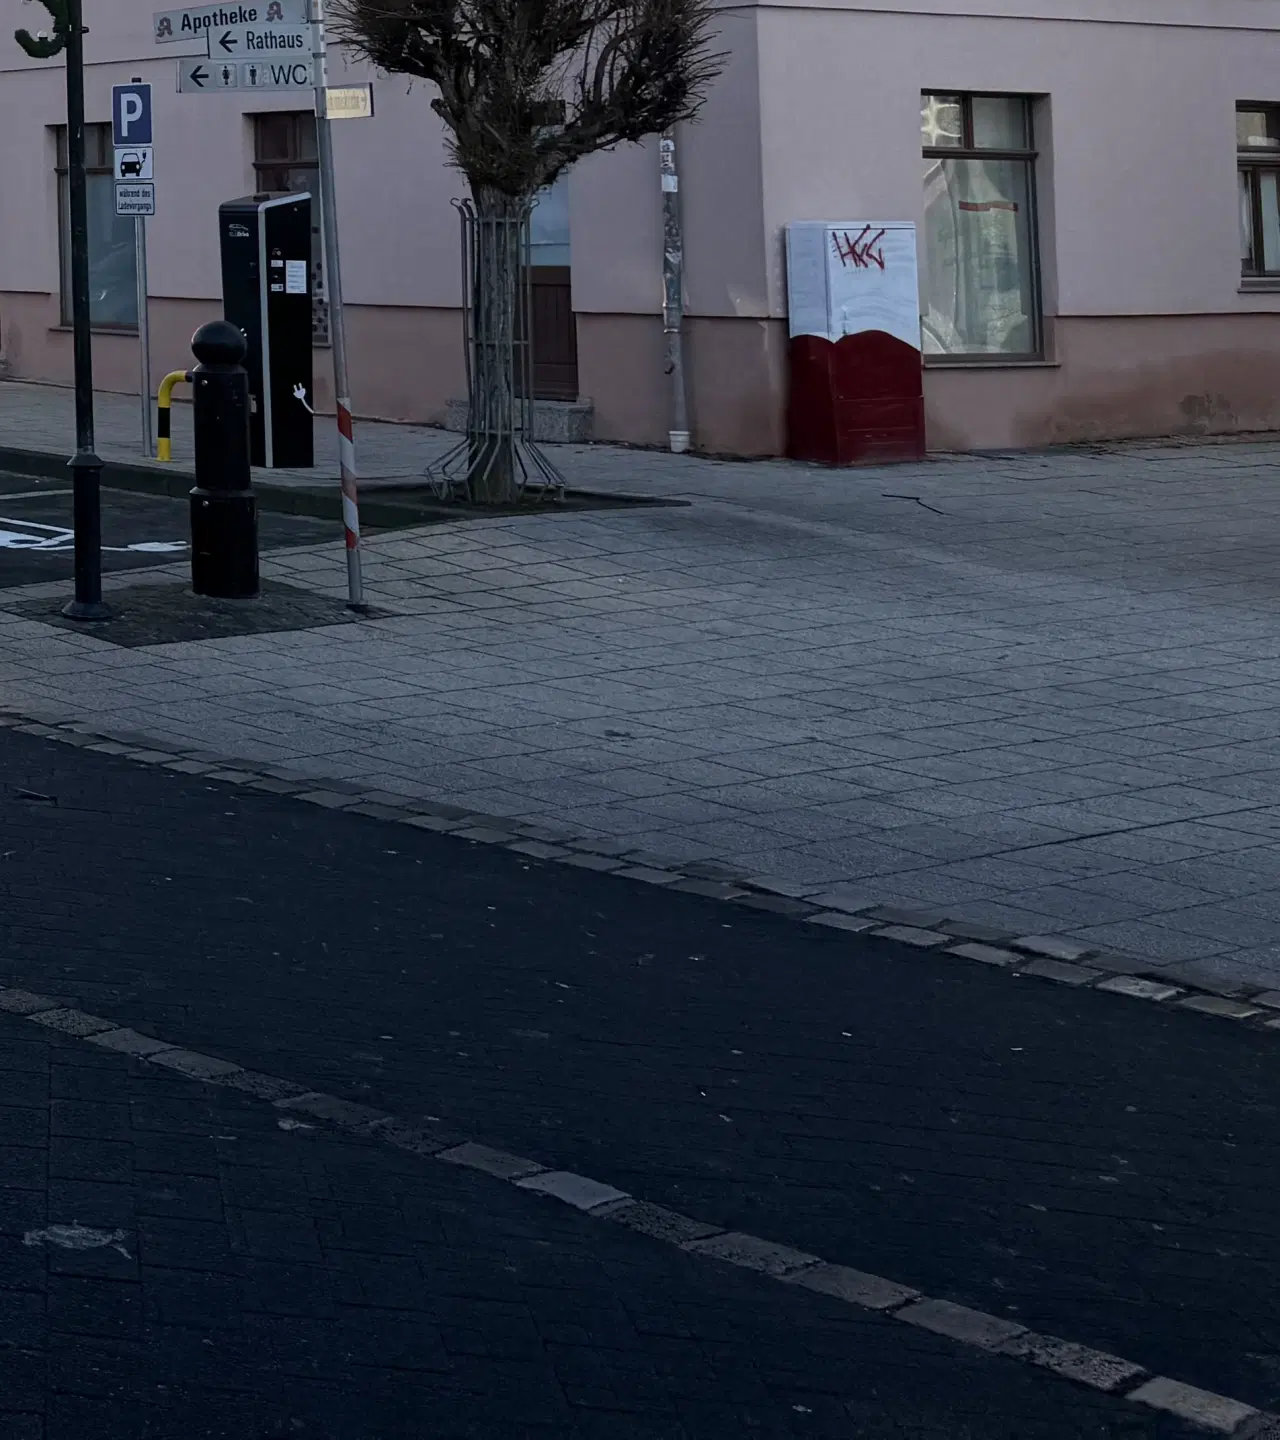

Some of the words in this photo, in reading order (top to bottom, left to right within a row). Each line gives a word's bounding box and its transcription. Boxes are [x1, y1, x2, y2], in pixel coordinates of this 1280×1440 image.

[181, 6, 257, 34] Apotheke
[246, 31, 303, 50] Rathaus
[271, 64, 308, 85] WC
[121, 93, 143, 137] P
